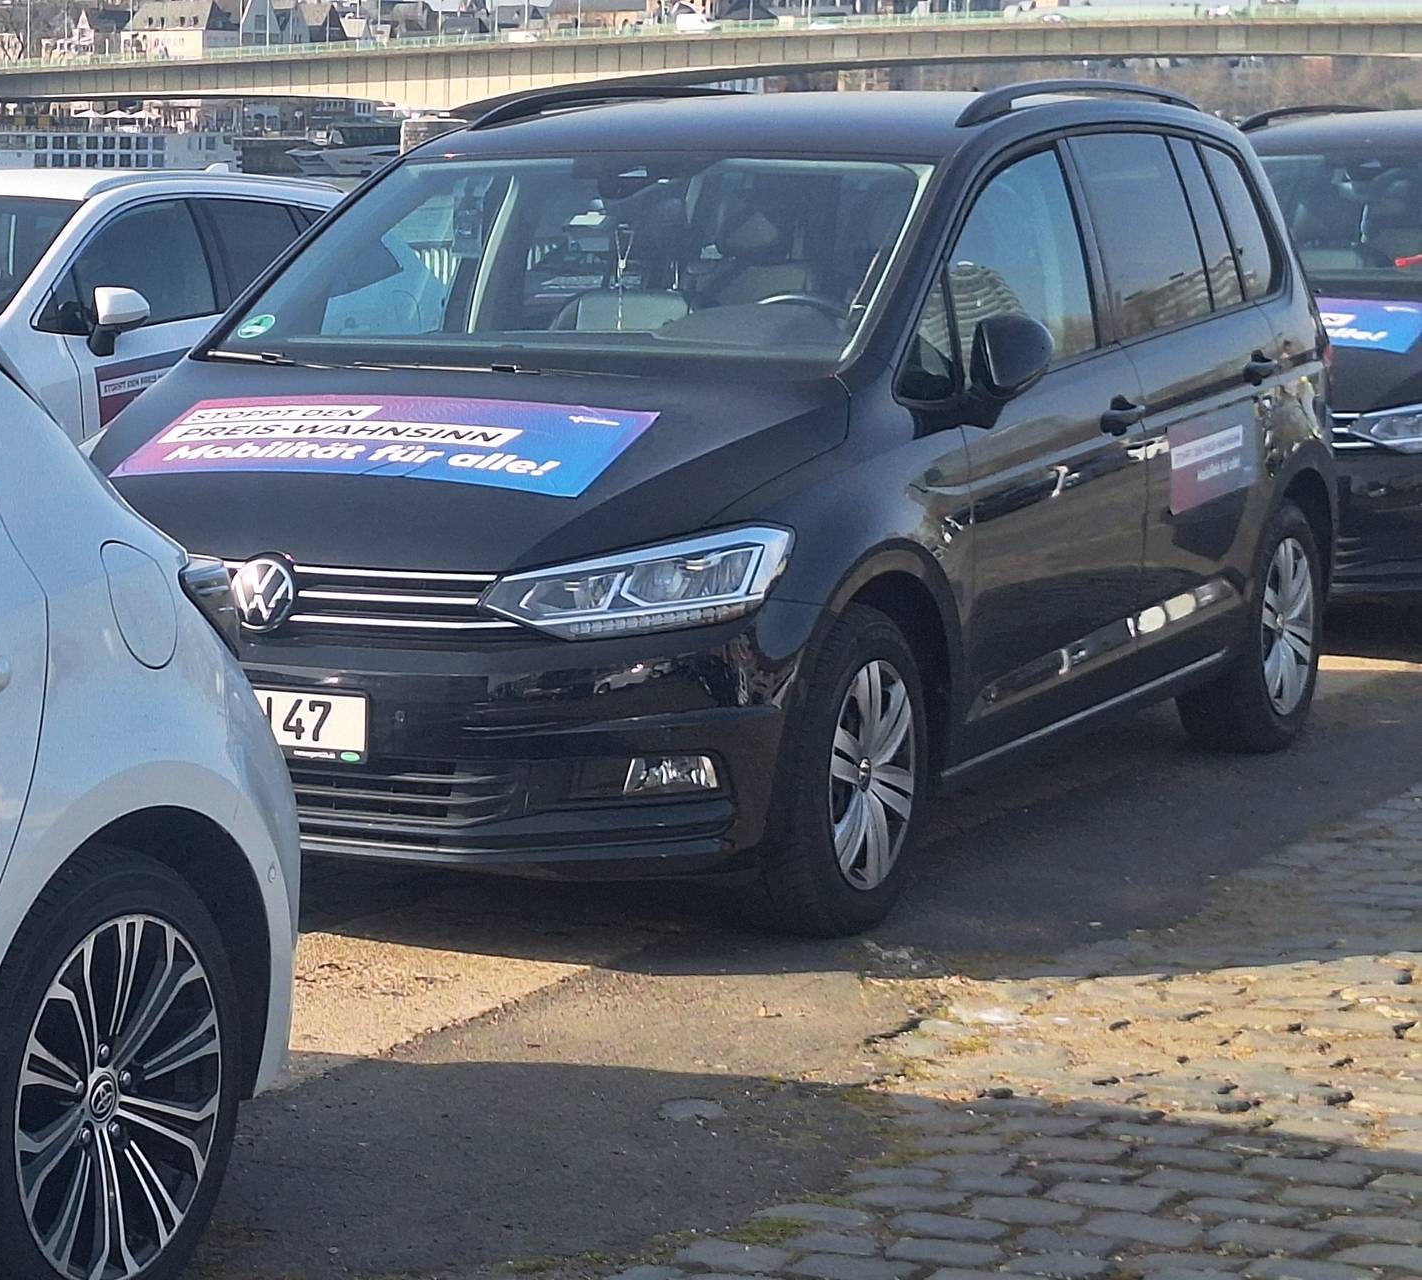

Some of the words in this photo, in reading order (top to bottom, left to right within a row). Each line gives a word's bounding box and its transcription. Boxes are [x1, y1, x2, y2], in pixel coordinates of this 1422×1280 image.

[191, 409, 300, 421] STOPPT
[300, 409, 363, 418] DEN
[176, 424, 503, 443] PREIS-WAHNSINN
[163, 441, 366, 461] Mobilität
[367, 444, 444, 463] für
[448, 452, 561, 476] alle!
[282, 699, 332, 741] 47
